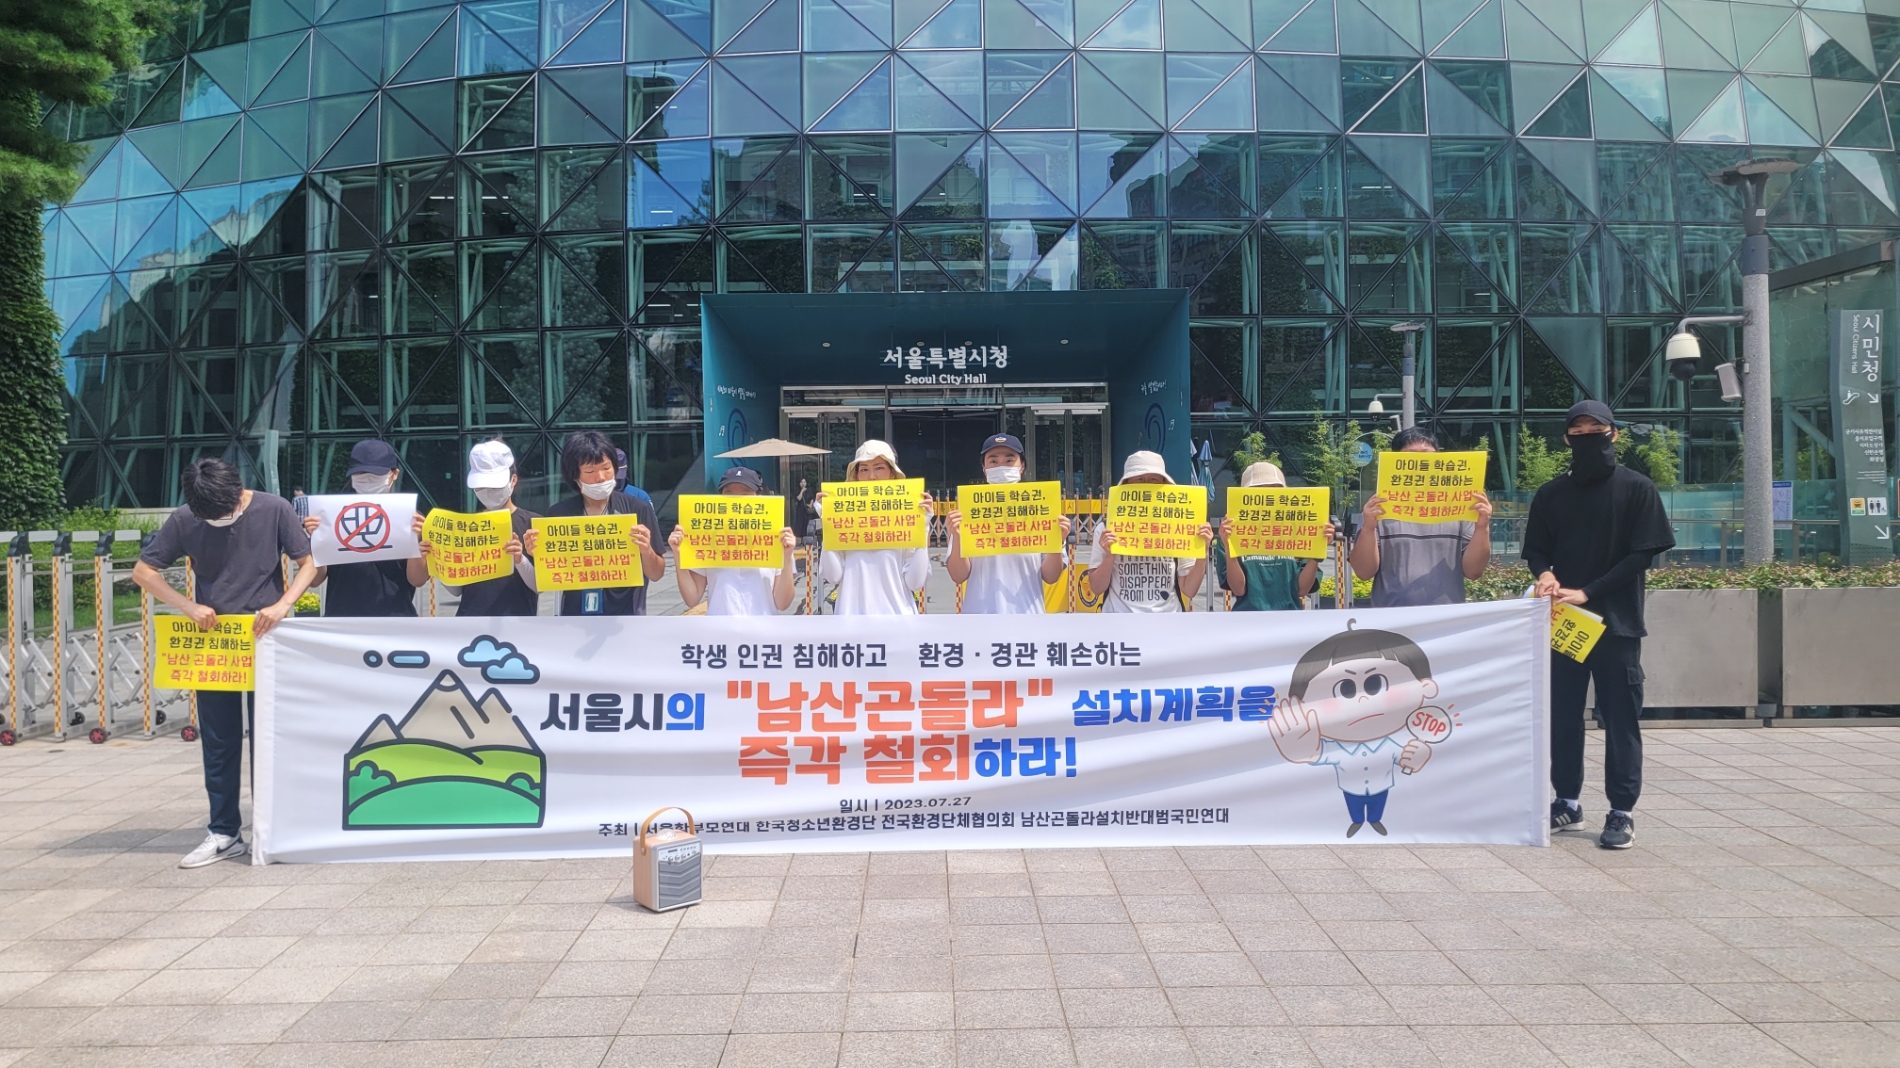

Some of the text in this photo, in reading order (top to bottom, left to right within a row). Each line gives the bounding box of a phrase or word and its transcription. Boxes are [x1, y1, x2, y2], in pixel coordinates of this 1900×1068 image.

[1861, 314, 1879, 381] 시민청
[884, 346, 1008, 369] 서울특별시청
[904, 373, 986, 385] Seoul City Hall
[1396, 459, 1470, 471] 아이들 학습권,
[1391, 475, 1473, 486] 환경권 침해하는
[837, 485, 909, 497] 아이들 학습권,
[973, 490, 1045, 503] 아이들 학습권,
[1121, 491, 1191, 504] 아이들 학습권,
[1383, 490, 1478, 502] "남산 곤돌라 사업"
[834, 499, 913, 512] 환경권 침해하는
[1243, 495, 1314, 506] 아이들 학습권,
[694, 503, 768, 515] 아이들 학습권,
[971, 505, 1049, 519] 환경권 침해하는
[1117, 506, 1195, 519] 환경권 침해하는
[1239, 510, 1317, 521] 환경권 침해하는
[1392, 505, 1466, 517] 즉각 철회하라!
[432, 516, 495, 532] 아이들 학습권,
[691, 518, 772, 530] 환경권 침해하는
[827, 514, 920, 529] "남산 곤돌라 사업"
[964, 520, 1056, 534] "남산 곤돌라 사업"
[1110, 522, 1135, 533] "남산
[1139, 523, 1171, 534] 곤돌라
[547, 523, 622, 536] 아이들 학습권,
[1232, 525, 1323, 536] "남산 곤돌라 사업"
[429, 530, 499, 547] 환경권 침해하는
[684, 534, 779, 546] "남산 곤돌라 사업"
[838, 531, 911, 543] 즉각 철회하라!
[976, 535, 1047, 549] 즉각 철회하라!
[1118, 537, 1190, 550] 즉각 철회하라!
[545, 539, 627, 552] 환경권 침해하는
[1240, 539, 1311, 550] 즉각 철회하라!
[444, 551, 475, 563] 곤돌라
[540, 554, 635, 569] "남산 곤돌라 사업"
[695, 550, 768, 561] 즉각 철회하라!
[448, 564, 496, 578] 철회하라!
[1118, 563, 1172, 575] SOMETHING
[552, 570, 627, 584] 즉각 철회하라!
[1120, 576, 1171, 588] DISAPPEAR
[1120, 589, 1160, 602] FROM US
[170, 636, 251, 650] 환경권 침해하는
[162, 652, 190, 665] "남산
[194, 654, 227, 666] 곤돌라
[680, 643, 728, 670] 학생
[737, 644, 783, 668] 인권
[793, 643, 887, 668] 침해하고
[918, 642, 964, 668] 환경
[990, 642, 1037, 667] 경관
[1046, 642, 1141, 667] 훼손하는
[171, 670, 247, 683] 즉각 철회하라!
[540, 678, 1276, 732] 서울시의 "남산곤돌라" 설치계획을
[1412, 712, 1446, 736] STOP
[738, 734, 1077, 785] 즉각 철회하라!
[840, 799, 868, 813] 일시
[884, 797, 971, 810] 2023.07.27
[598, 823, 627, 837] 주최
[756, 815, 876, 833] 한국청소년환경단
[881, 811, 1015, 830] 전국환경단체협의회
[1021, 808, 1229, 828] 남산곤돌라설치반대범국민연대
